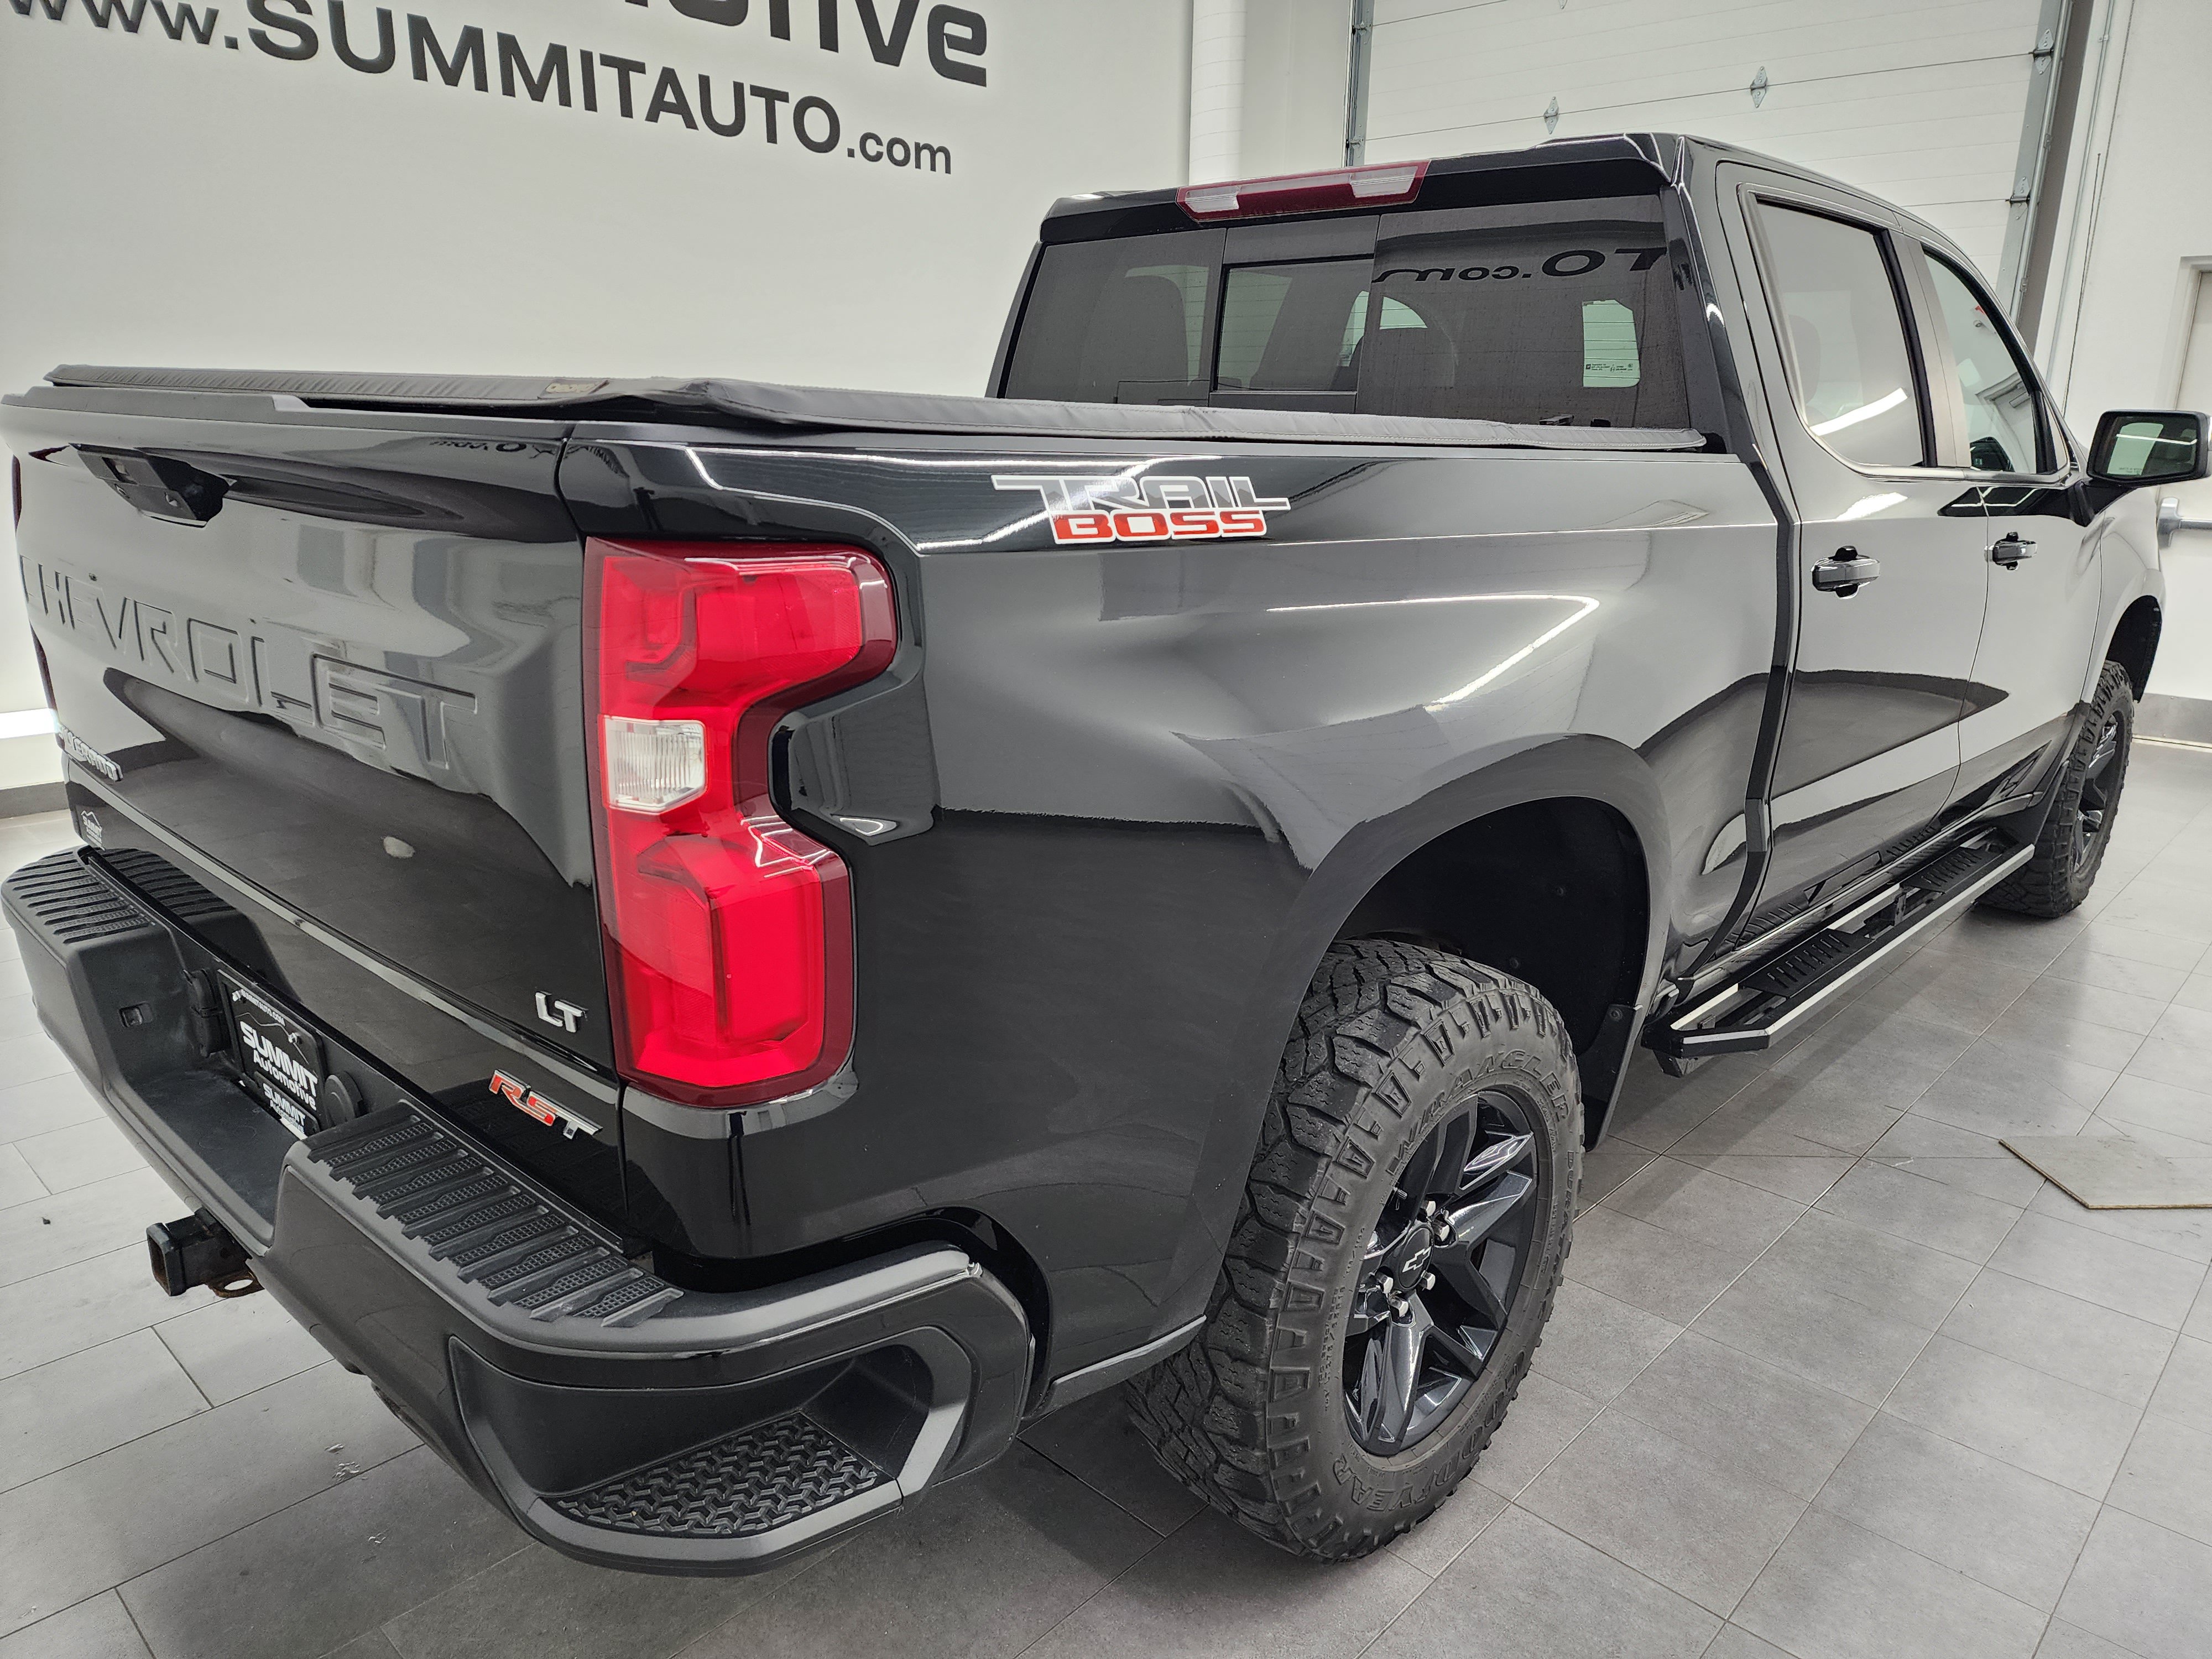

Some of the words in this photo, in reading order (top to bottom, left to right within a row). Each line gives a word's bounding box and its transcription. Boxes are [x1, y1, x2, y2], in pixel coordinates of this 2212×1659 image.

[991, 475, 1291, 510] TRAIL
[1051, 509, 1267, 544] BOSS
[19, 555, 478, 770] CHEVROLET
[535, 991, 586, 1032] LT
[239, 1021, 319, 1097] SUMMIT
[253, 1049, 317, 1111] Automotive
[263, 1083, 305, 1125] SUMMIT
[488, 1070, 603, 1140] RST
